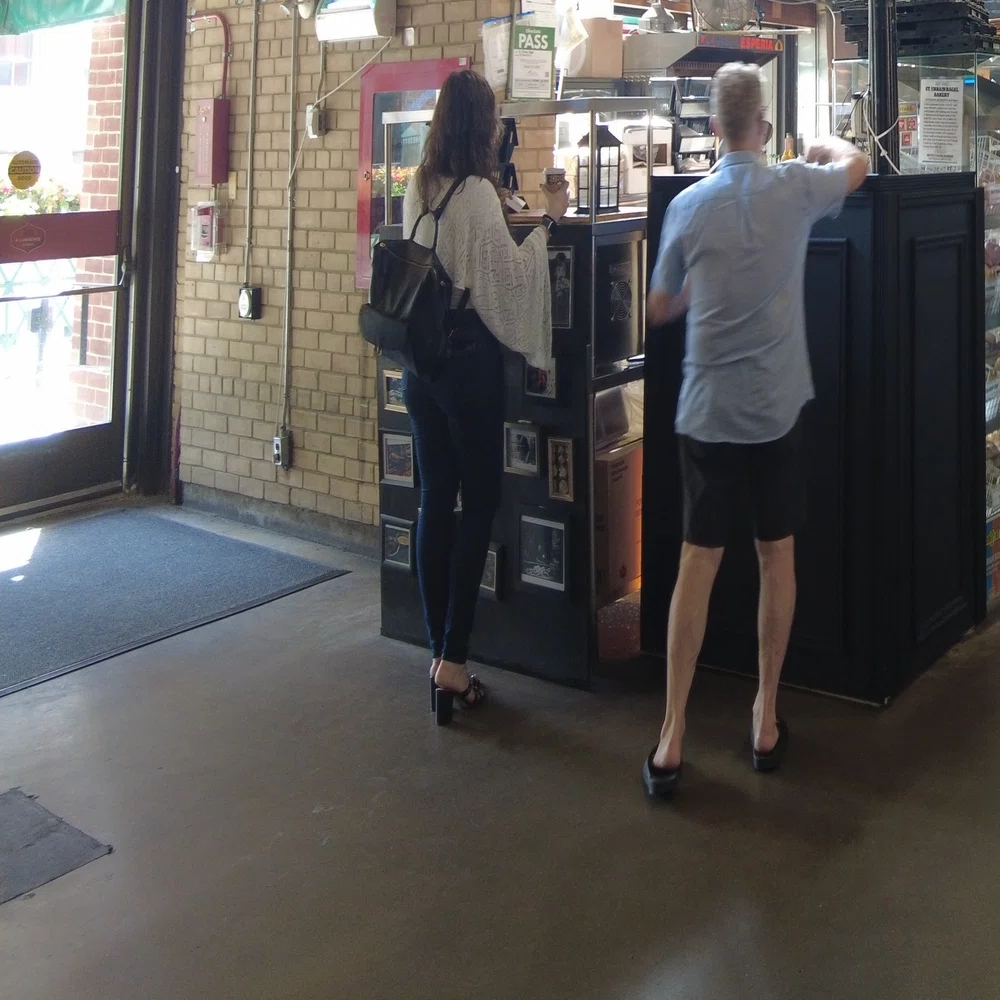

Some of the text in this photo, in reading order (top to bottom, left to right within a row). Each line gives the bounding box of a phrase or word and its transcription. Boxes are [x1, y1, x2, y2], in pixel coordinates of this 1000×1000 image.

[518, 33, 549, 49] PASS
[740, 36, 774, 50] ESPERIA
[10, 166, 40, 174] CAUTION
